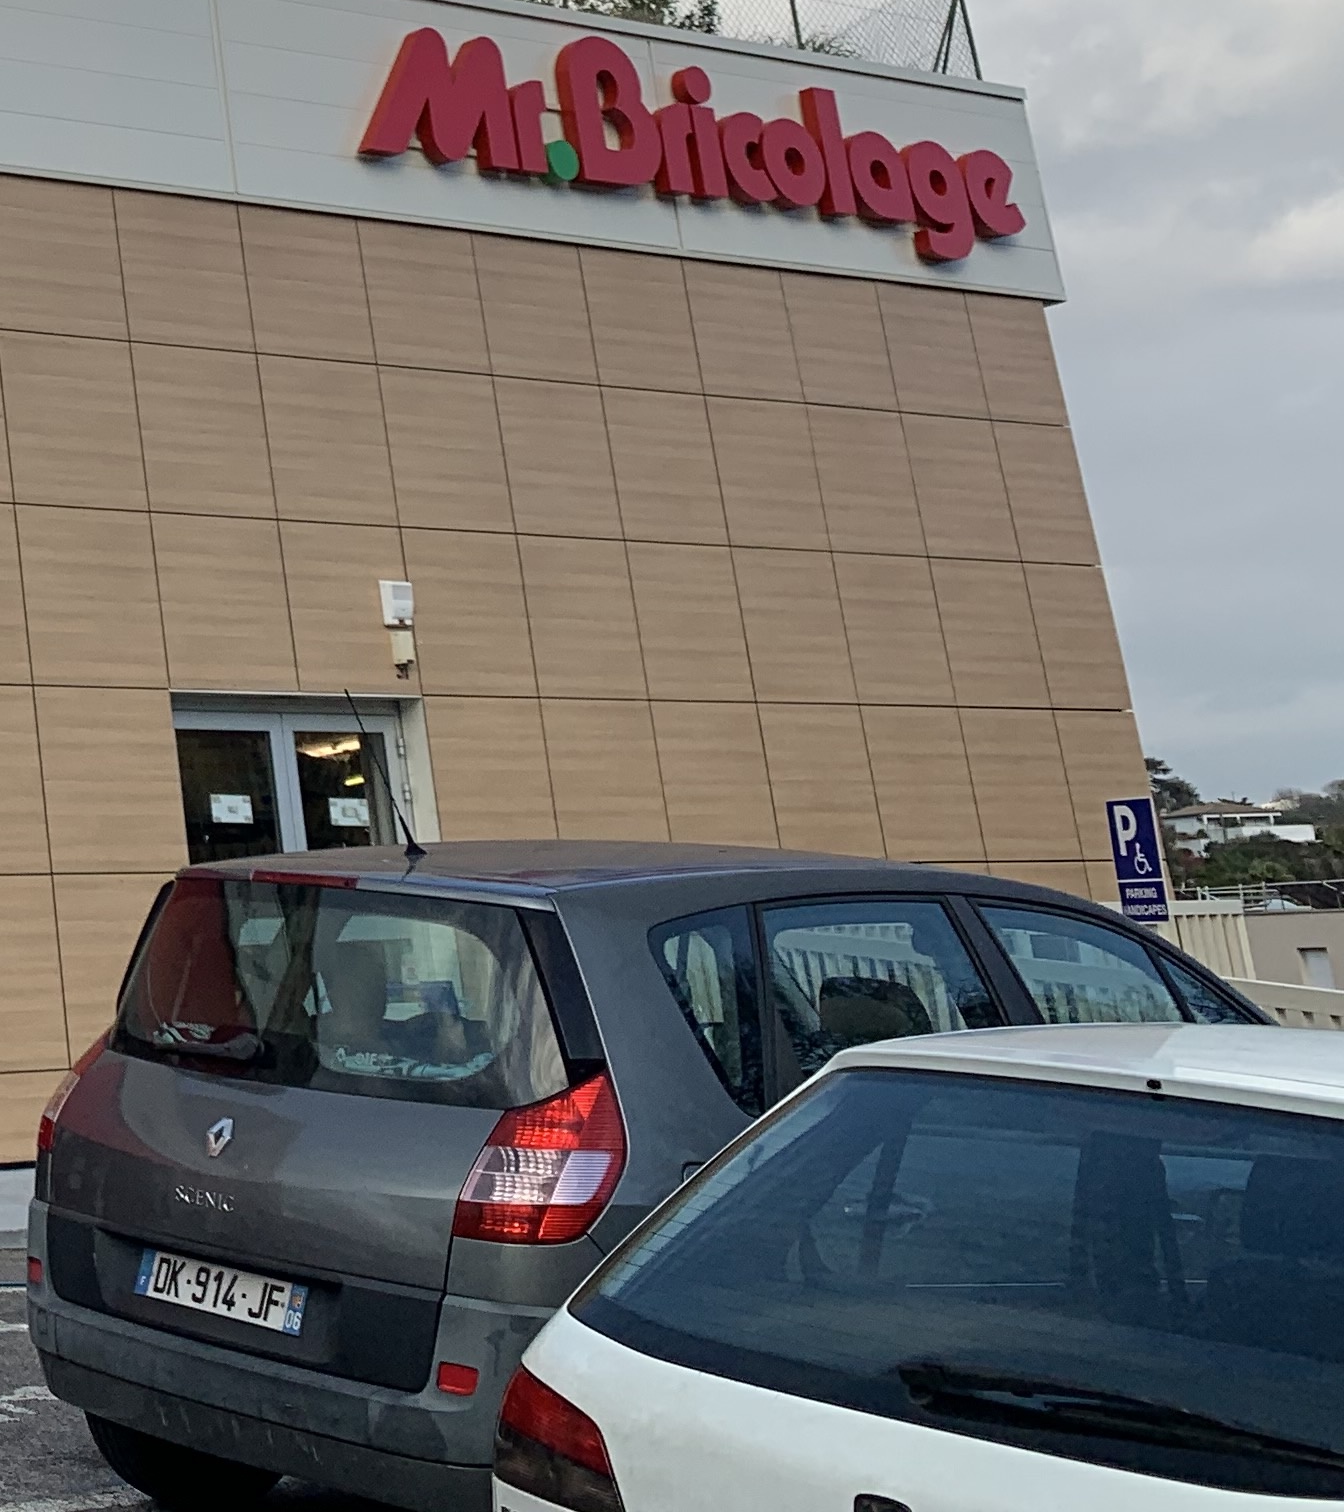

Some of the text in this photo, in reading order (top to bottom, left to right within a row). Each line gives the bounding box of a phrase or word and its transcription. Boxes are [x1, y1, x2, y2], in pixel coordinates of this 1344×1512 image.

[1113, 805, 1137, 857] P
[1125, 887, 1158, 899] PARKING
[284, 1309, 302, 1331] 06
